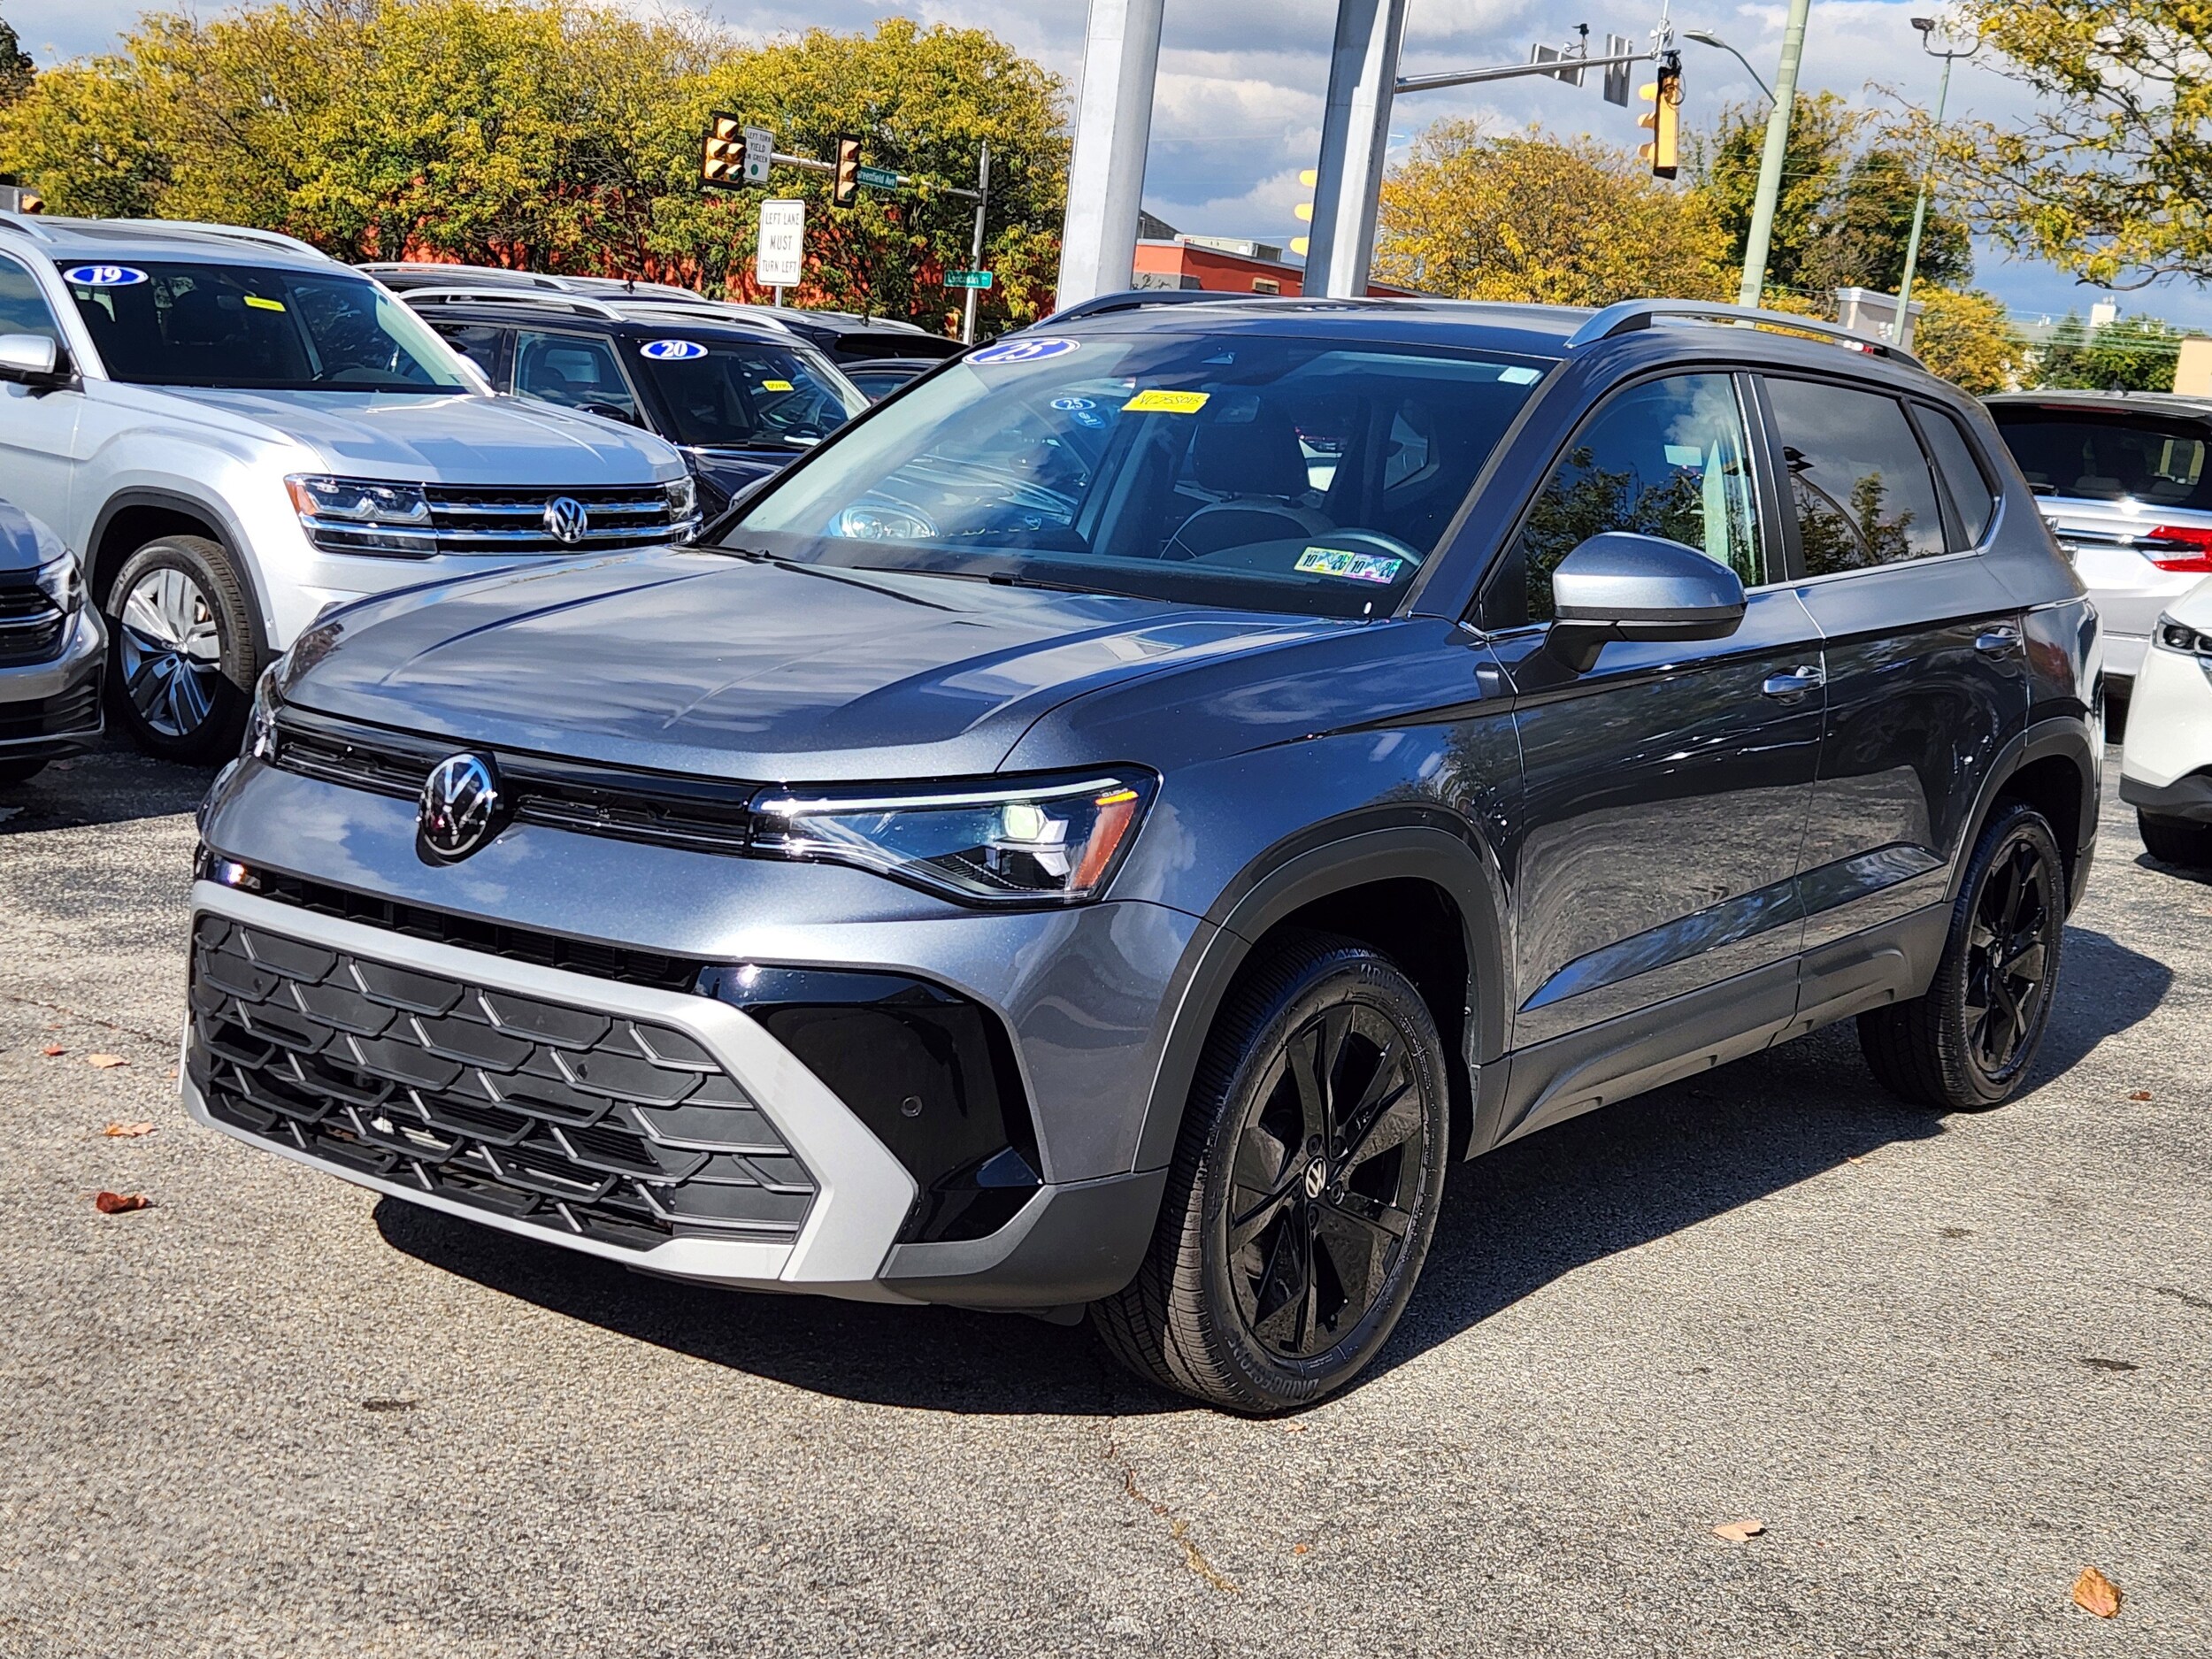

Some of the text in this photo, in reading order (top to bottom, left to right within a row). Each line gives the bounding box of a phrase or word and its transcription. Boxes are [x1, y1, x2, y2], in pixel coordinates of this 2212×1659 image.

[759, 134, 771, 142] TURN
[750, 142, 766, 153] YIELD
[752, 153, 768, 164] GREEN
[764, 212, 800, 226] LEFT LANE
[770, 234, 793, 250] MUST
[762, 259, 797, 273] TURN LEFT
[91, 266, 122, 283] 19
[660, 342, 688, 357] 20
[979, 340, 1064, 363] 25
[1063, 398, 1084, 410] 25
[1302, 554, 1318, 567] 10
[1350, 560, 1365, 573] 10
